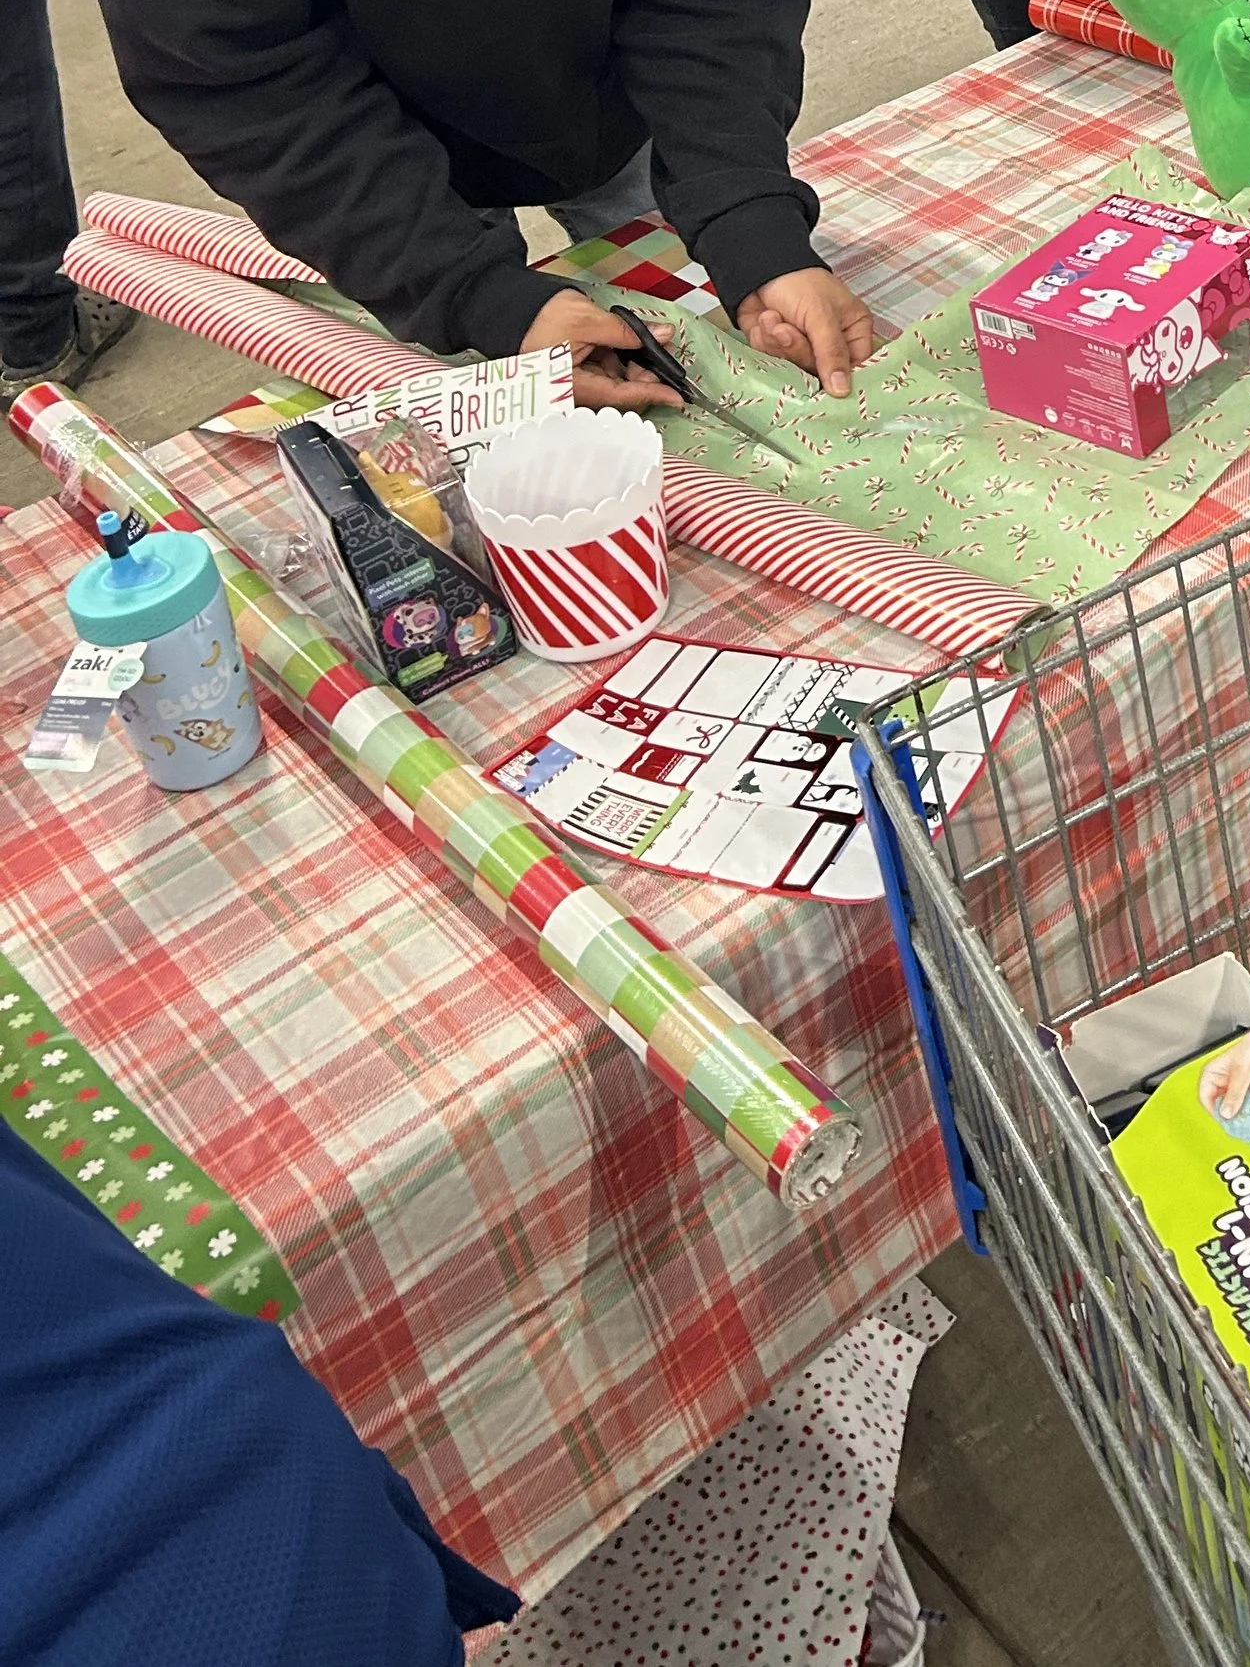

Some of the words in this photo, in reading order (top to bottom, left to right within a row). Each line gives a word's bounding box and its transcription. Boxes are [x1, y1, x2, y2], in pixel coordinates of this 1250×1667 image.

[1097, 206, 1129, 218] AND
[1128, 213, 1187, 234] FRIENDS
[1107, 197, 1151, 214] HELLO
[1152, 208, 1199, 227] KITTY
[451, 371, 542, 438] BRIGHT
[70, 655, 114, 672] zak!
[585, 693, 618, 715] LA
[606, 701, 640, 723] LA
[626, 707, 660, 730] FA
[590, 800, 621, 827] THING
[605, 803, 633, 832] EVERY
[614, 807, 645, 836] MERRY
